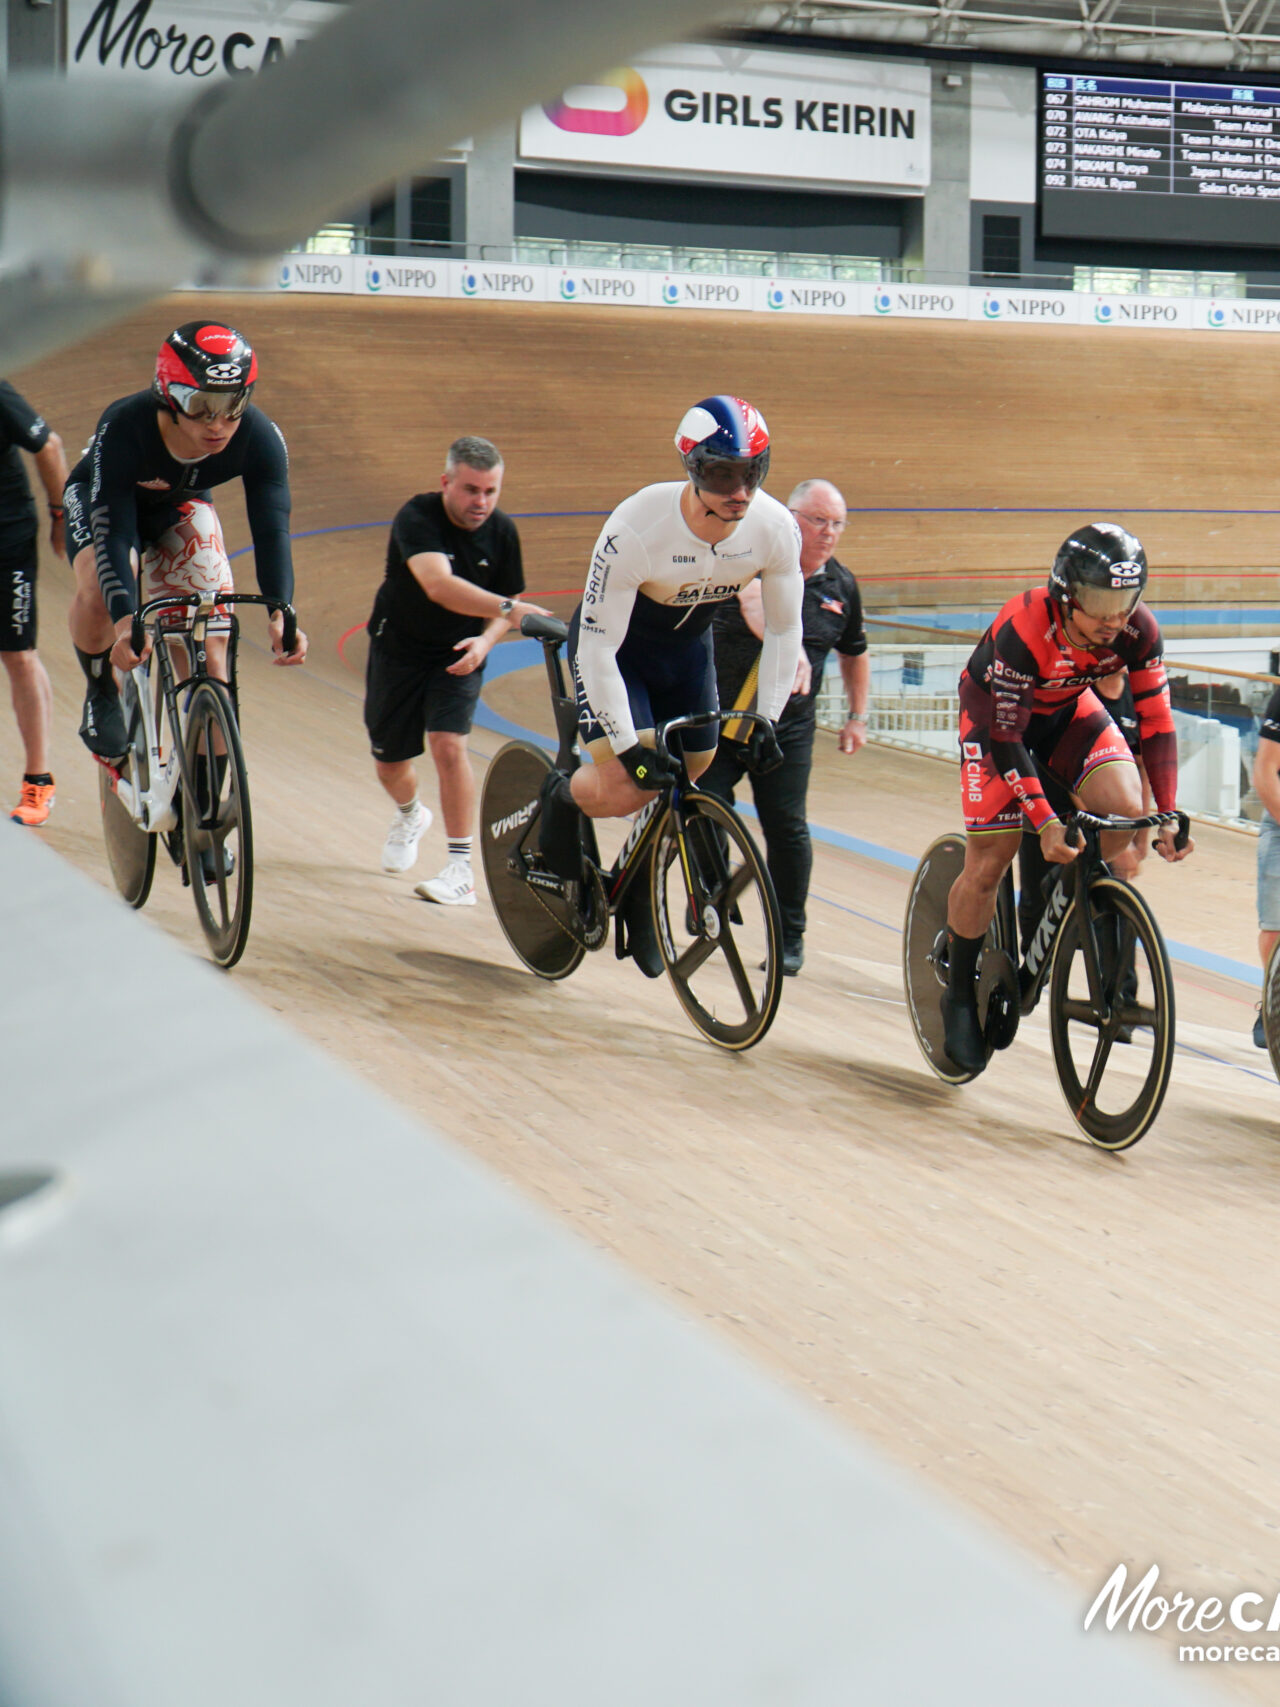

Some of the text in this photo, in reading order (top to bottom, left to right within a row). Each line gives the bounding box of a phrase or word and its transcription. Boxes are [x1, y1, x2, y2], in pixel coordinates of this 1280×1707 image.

[1046, 93, 1067, 105] 067
[664, 89, 915, 139] GIRLS KEIRIN
[1046, 110, 1067, 121] 070
[1232, 105, 1273, 118] National
[1046, 126, 1067, 137] 072
[1213, 119, 1243, 131] Team
[1075, 128, 1097, 140] OTA
[1181, 134, 1211, 146] Team
[1255, 138, 1264, 148] K
[1046, 142, 1067, 153] 073
[1045, 158, 1066, 169] 074
[1181, 150, 1211, 162] Team
[1255, 153, 1264, 164] K
[1045, 174, 1066, 186] 092
[1191, 166, 1221, 179] Japan
[1222, 168, 1264, 180] National
[1074, 176, 1137, 191] HERAL Ryan
[1199, 182, 1227, 194] Salon
[295, 264, 342, 285] NIPPO
[386, 269, 436, 288] NIPPO
[482, 273, 533, 294] NIPPO
[580, 277, 635, 297] NIPPO
[684, 283, 739, 302] NIPPO
[789, 288, 846, 308] NIPPO
[896, 291, 954, 312] NIPPO
[1007, 298, 1065, 317] NIPPO
[1118, 303, 1177, 322] NIPPO
[672, 555, 696, 564] GOBIK
[1122, 578, 1140, 586] CIMB
[678, 583, 741, 600] SALON
[11, 570, 24, 635] JAPAN
[1083, 745, 1119, 766] AZIZUL
[966, 760, 983, 803] CIMB
[1013, 784, 1035, 812] CIMB
